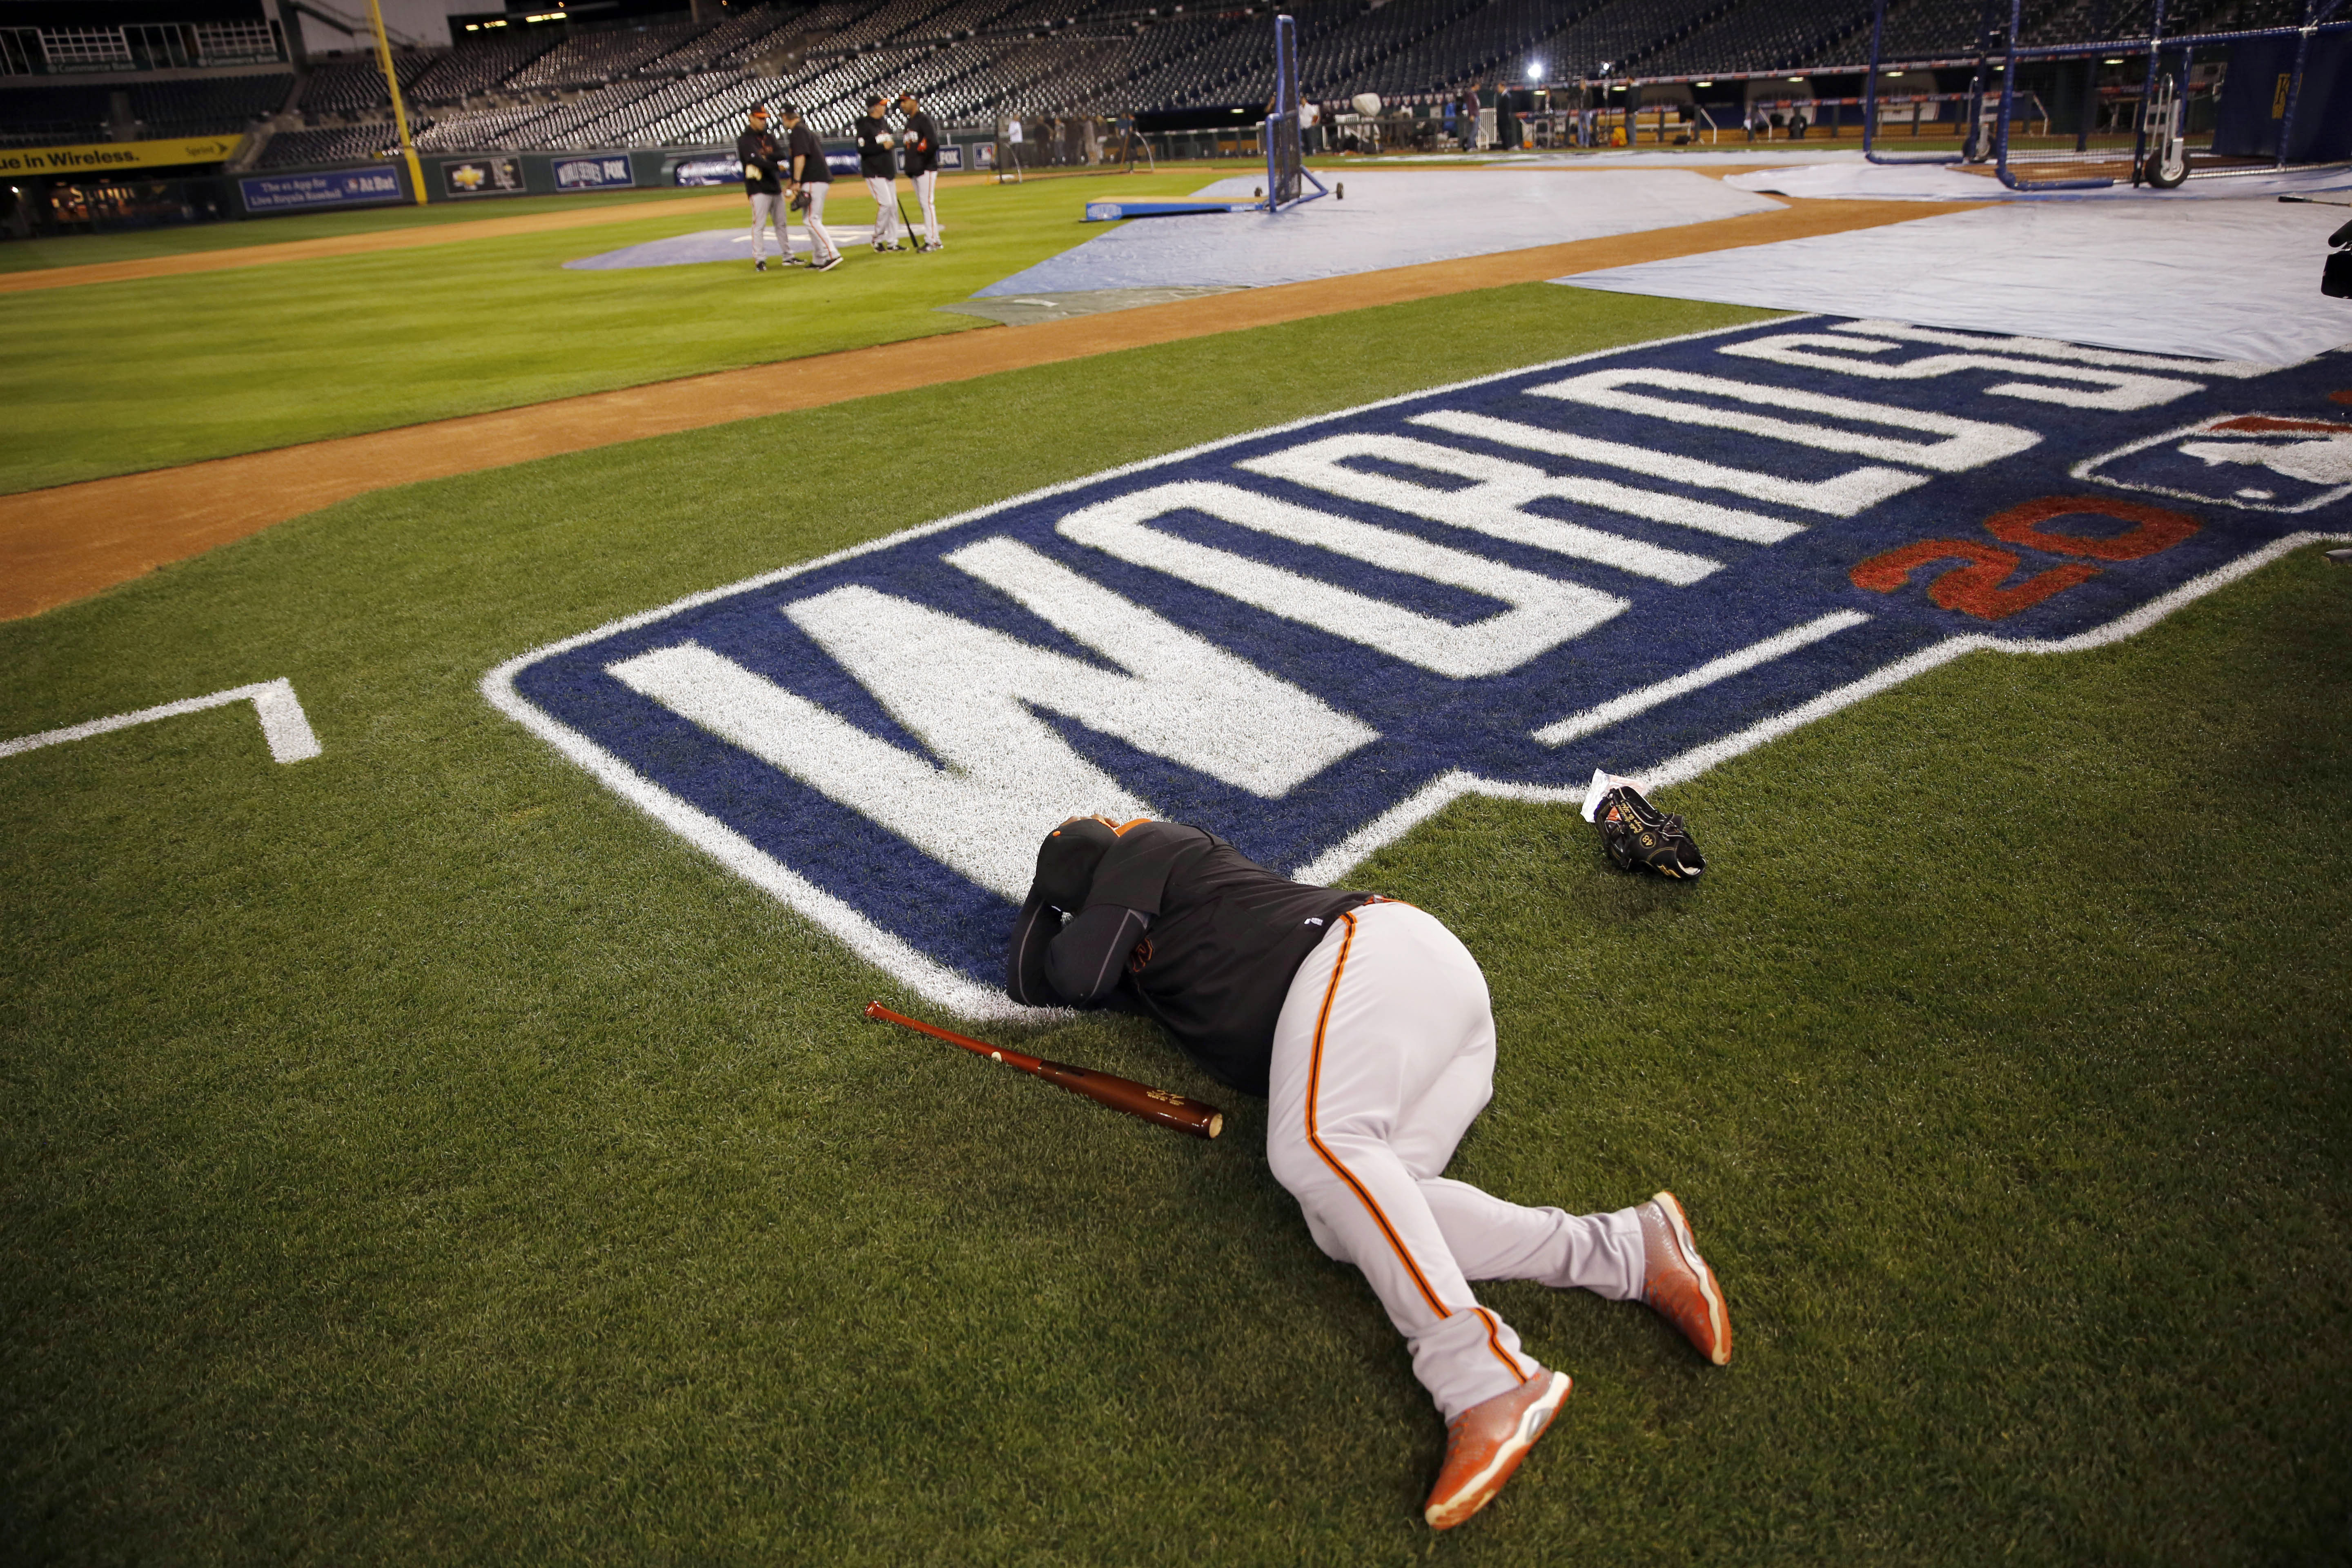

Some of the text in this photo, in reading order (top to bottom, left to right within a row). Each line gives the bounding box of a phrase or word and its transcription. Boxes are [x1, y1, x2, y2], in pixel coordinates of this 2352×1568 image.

[23, 154, 45, 168] in
[47, 150, 140, 166] Wireless.
[939, 150, 959, 164] FOX
[602, 160, 628, 180] FOX
[1849, 494, 2204, 621] 20
[1642, 835, 1653, 846] 48
